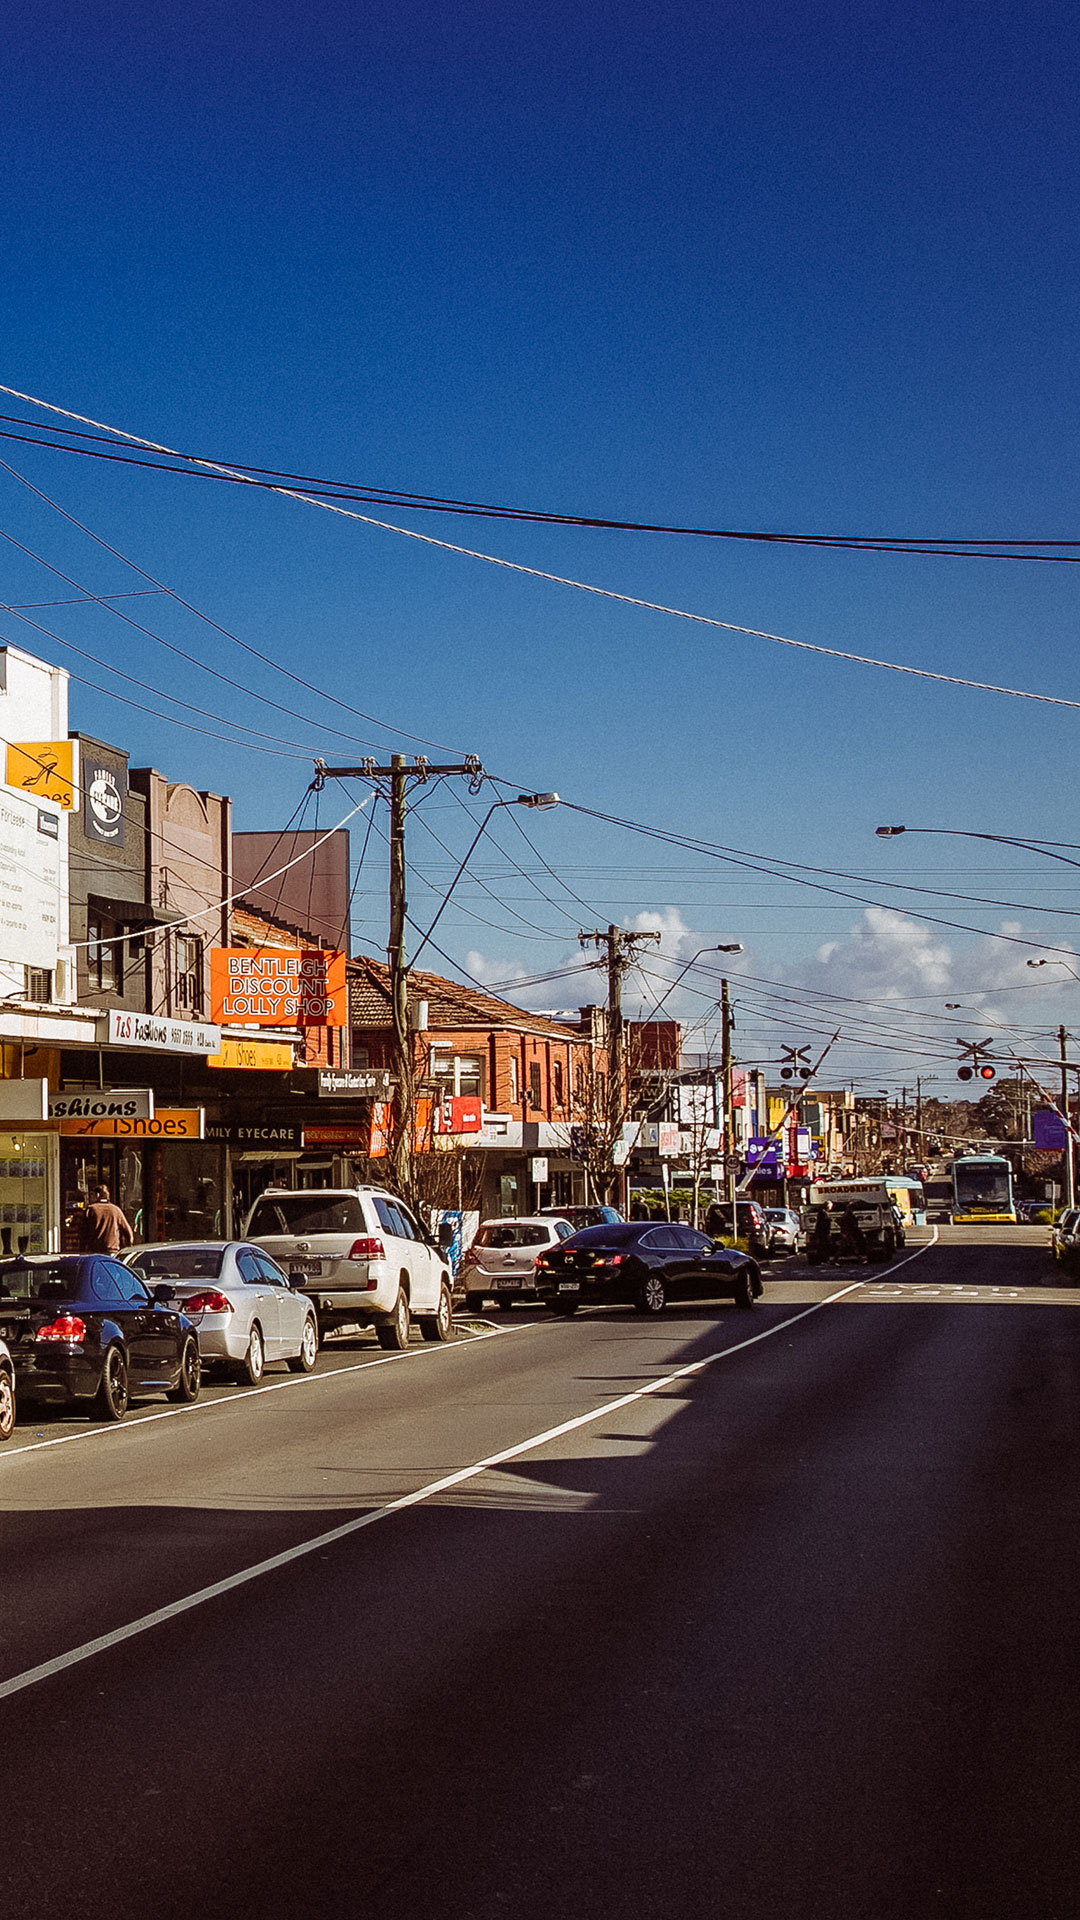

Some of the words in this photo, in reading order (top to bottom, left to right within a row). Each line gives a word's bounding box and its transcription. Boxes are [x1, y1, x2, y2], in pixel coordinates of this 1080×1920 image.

[228, 957, 328, 976] BENTLEIGH
[230, 977, 329, 996] DISCOUNT
[223, 997, 281, 1015] LOLLY
[284, 998, 335, 1016] SHOP
[134, 1018, 167, 1044] Fashions
[49, 1098, 137, 1117] shions
[205, 1127, 232, 1138] MILY
[238, 1127, 294, 1139] EYECARE
